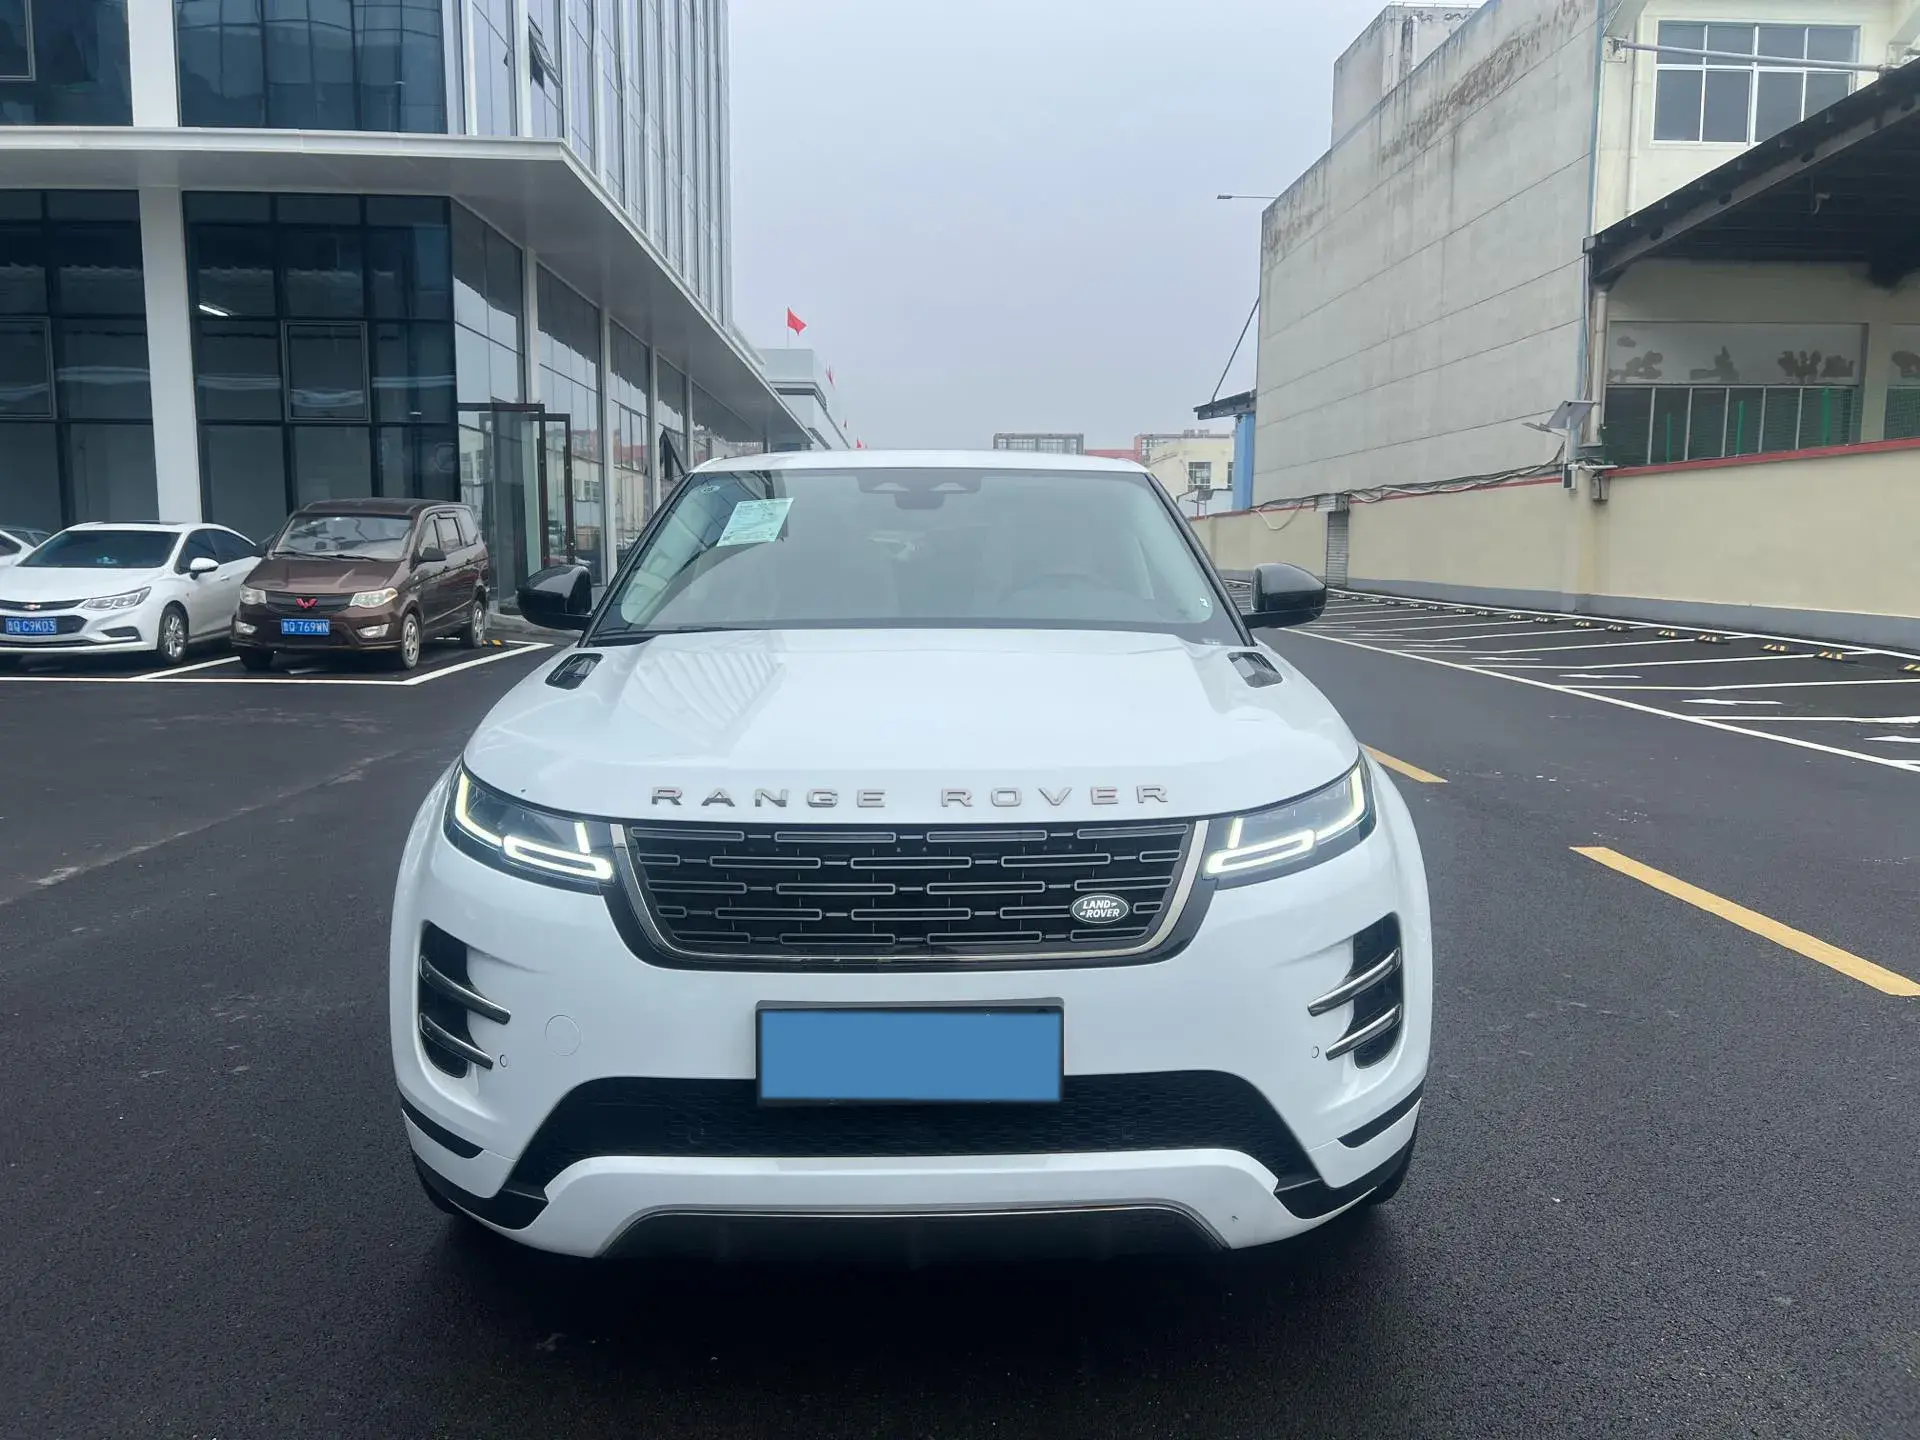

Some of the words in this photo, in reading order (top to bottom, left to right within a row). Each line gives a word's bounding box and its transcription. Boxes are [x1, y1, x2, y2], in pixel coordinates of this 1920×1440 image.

[651, 786, 886, 808] RANGE
[941, 785, 1168, 807] ROVER
[1082, 900, 1110, 909] LAND
[1085, 908, 1120, 918] ROVER
